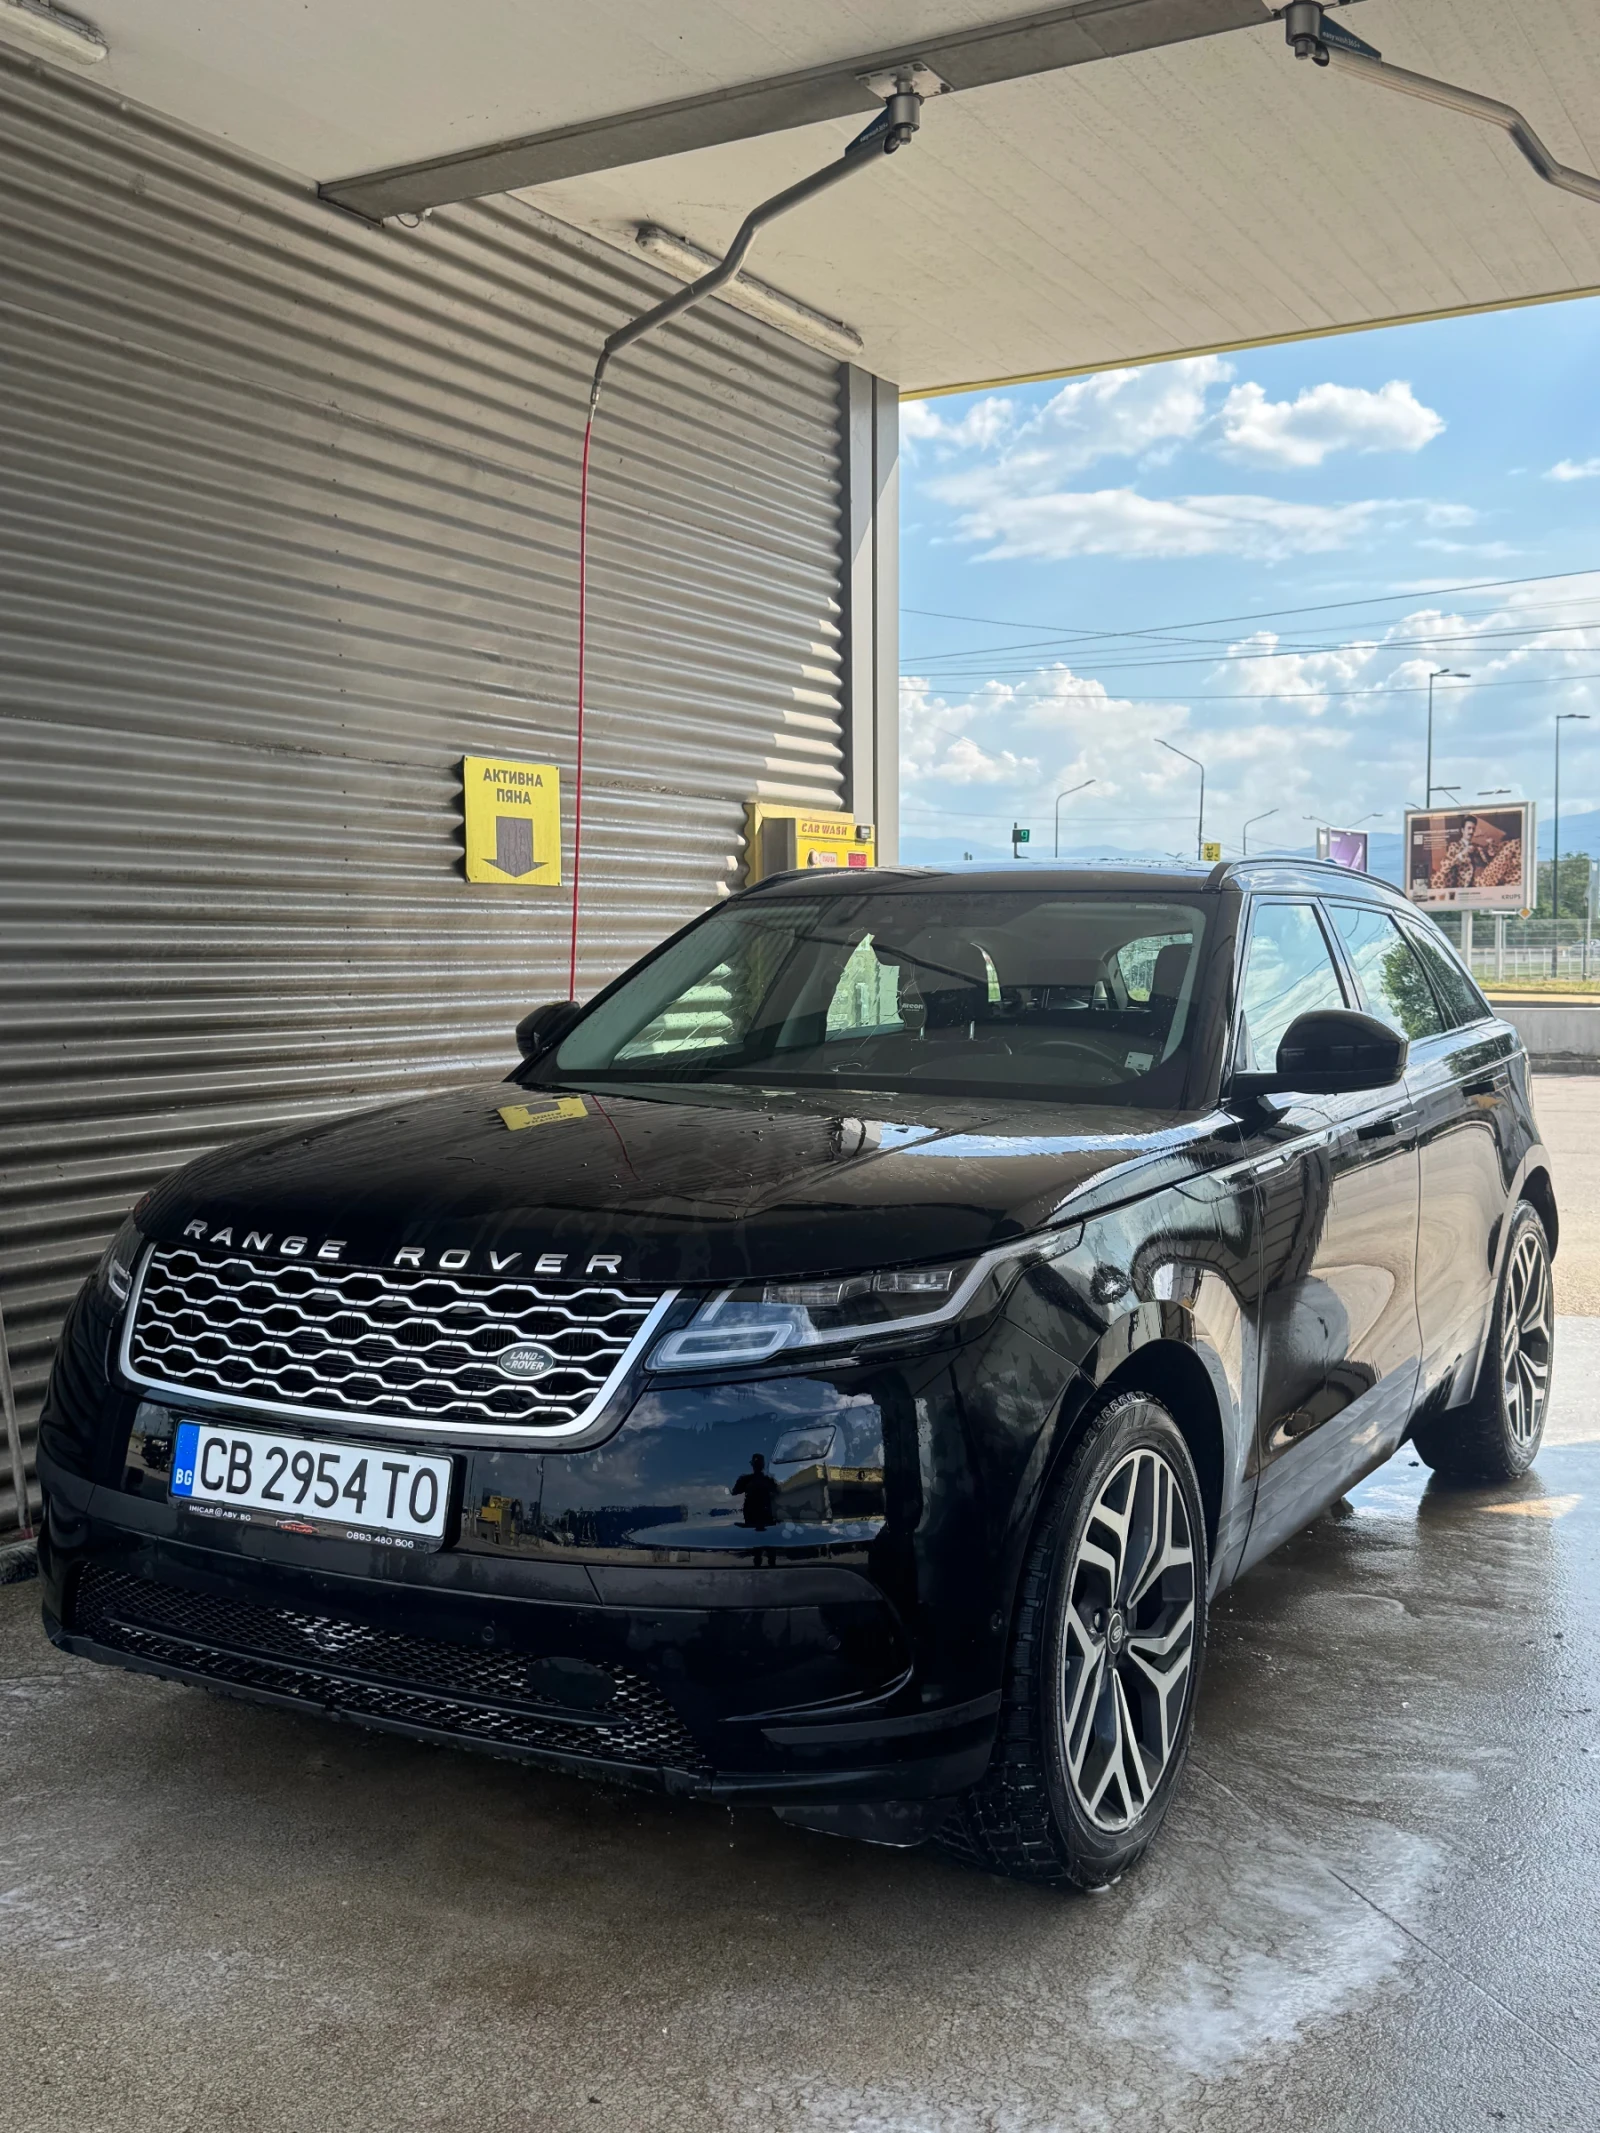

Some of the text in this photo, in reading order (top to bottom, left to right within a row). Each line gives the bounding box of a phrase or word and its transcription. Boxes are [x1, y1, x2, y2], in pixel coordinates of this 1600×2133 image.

[483, 767, 544, 788] АКТИВНА
[496, 788, 532, 805] ПЯНА
[801, 823, 848, 836] CAR WASH
[183, 1218, 624, 1275] RANGE ROVER
[510, 1351, 538, 1361] LAND
[510, 1360, 545, 1370] ROVER
[175, 1467, 193, 1487] BG
[200, 1437, 439, 1524] CB 2954 TO
[346, 1530, 372, 1542] 0893
[374, 1535, 393, 1546] 480
